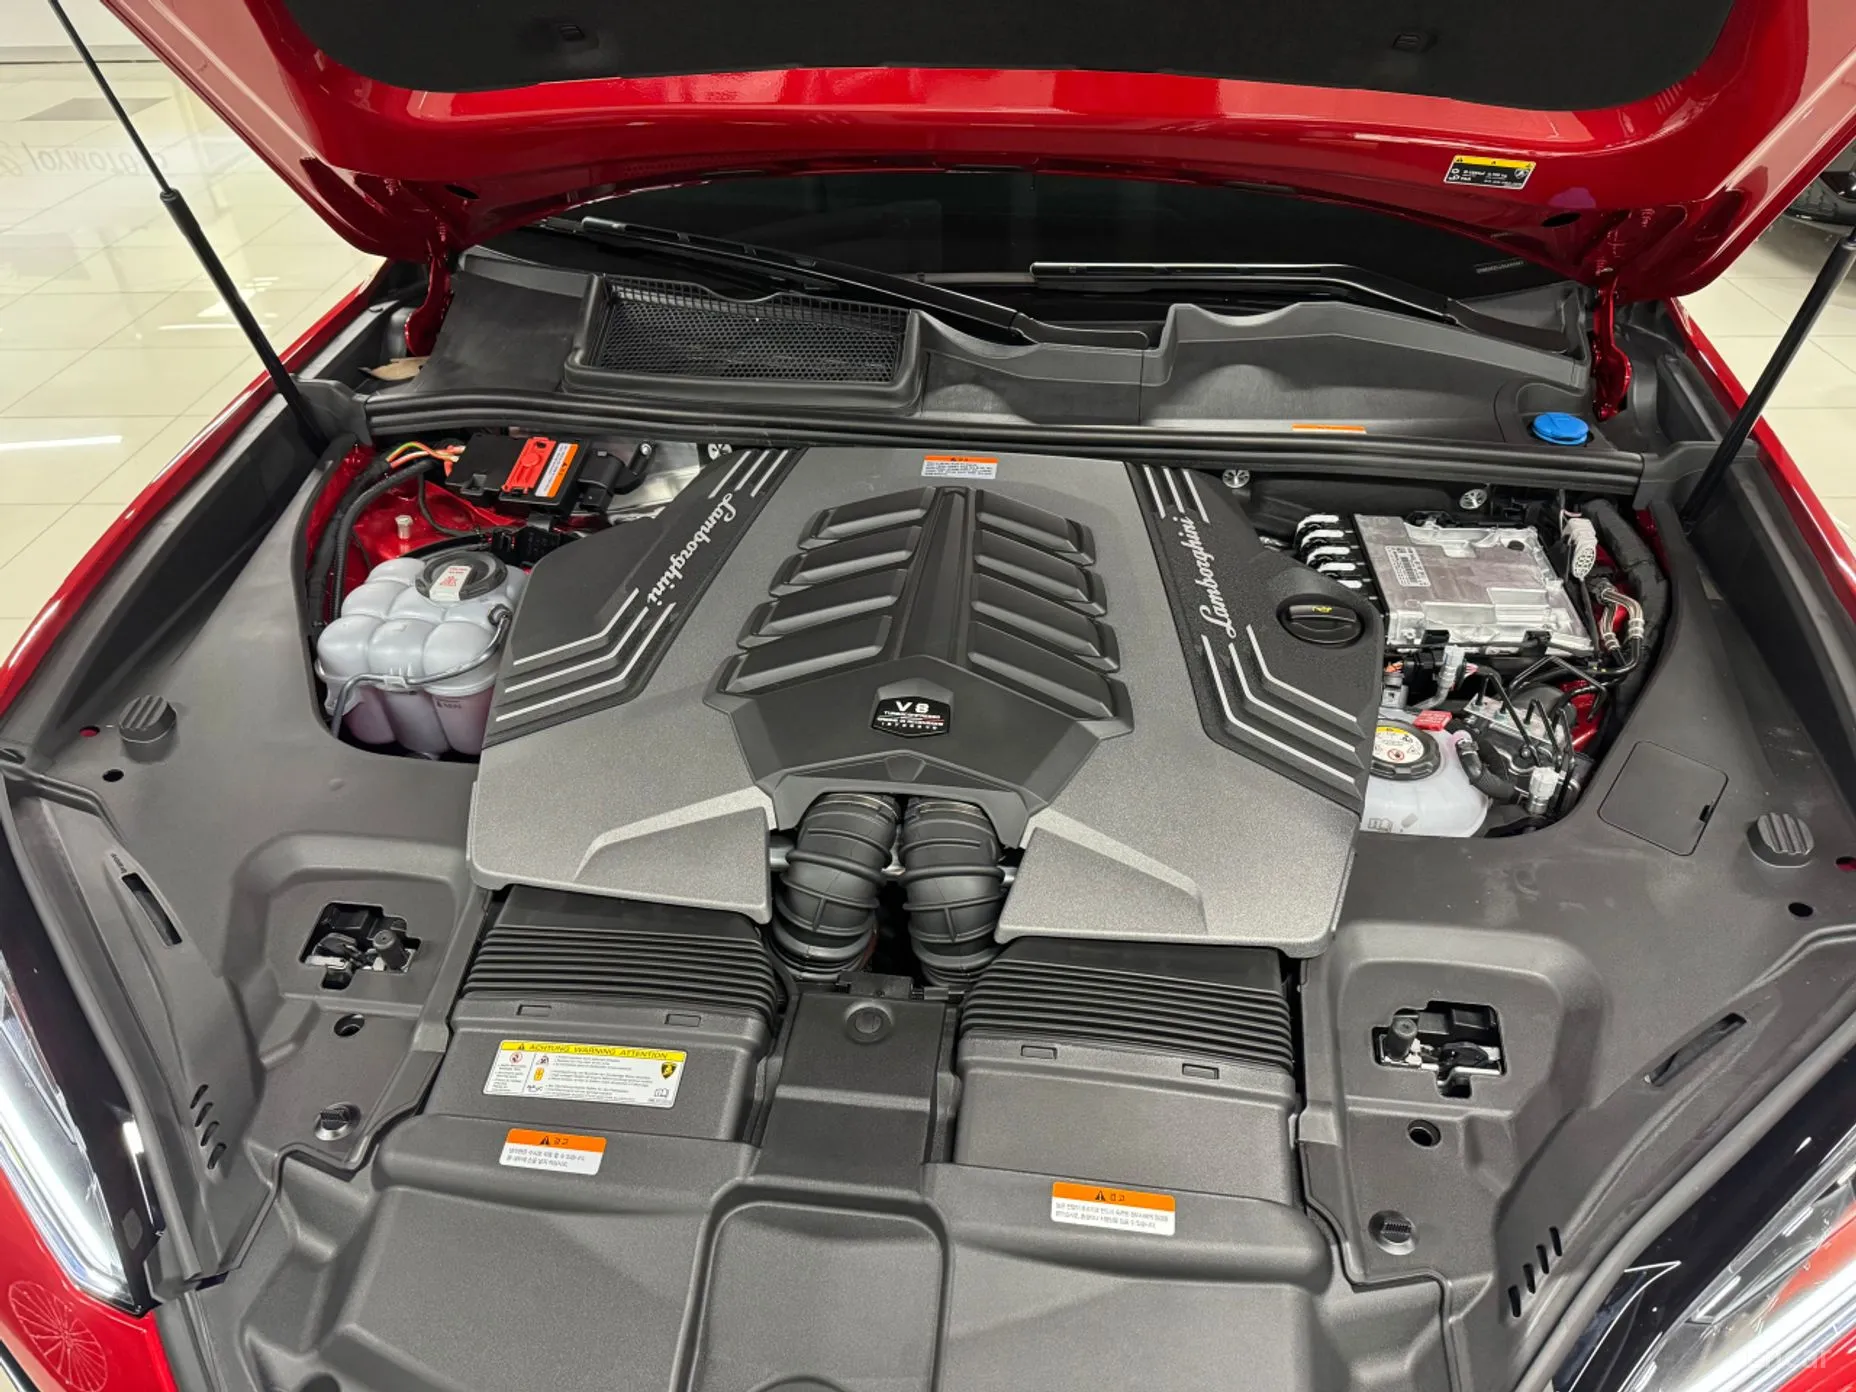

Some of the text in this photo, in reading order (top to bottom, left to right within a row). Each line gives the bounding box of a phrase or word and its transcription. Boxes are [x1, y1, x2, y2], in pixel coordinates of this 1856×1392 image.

[646, 492, 737, 606] Lamborghini
[1172, 516, 1236, 638] Lamborghini
[529, 1043, 668, 1060] ACHTUNG WARNING ATTENTION
